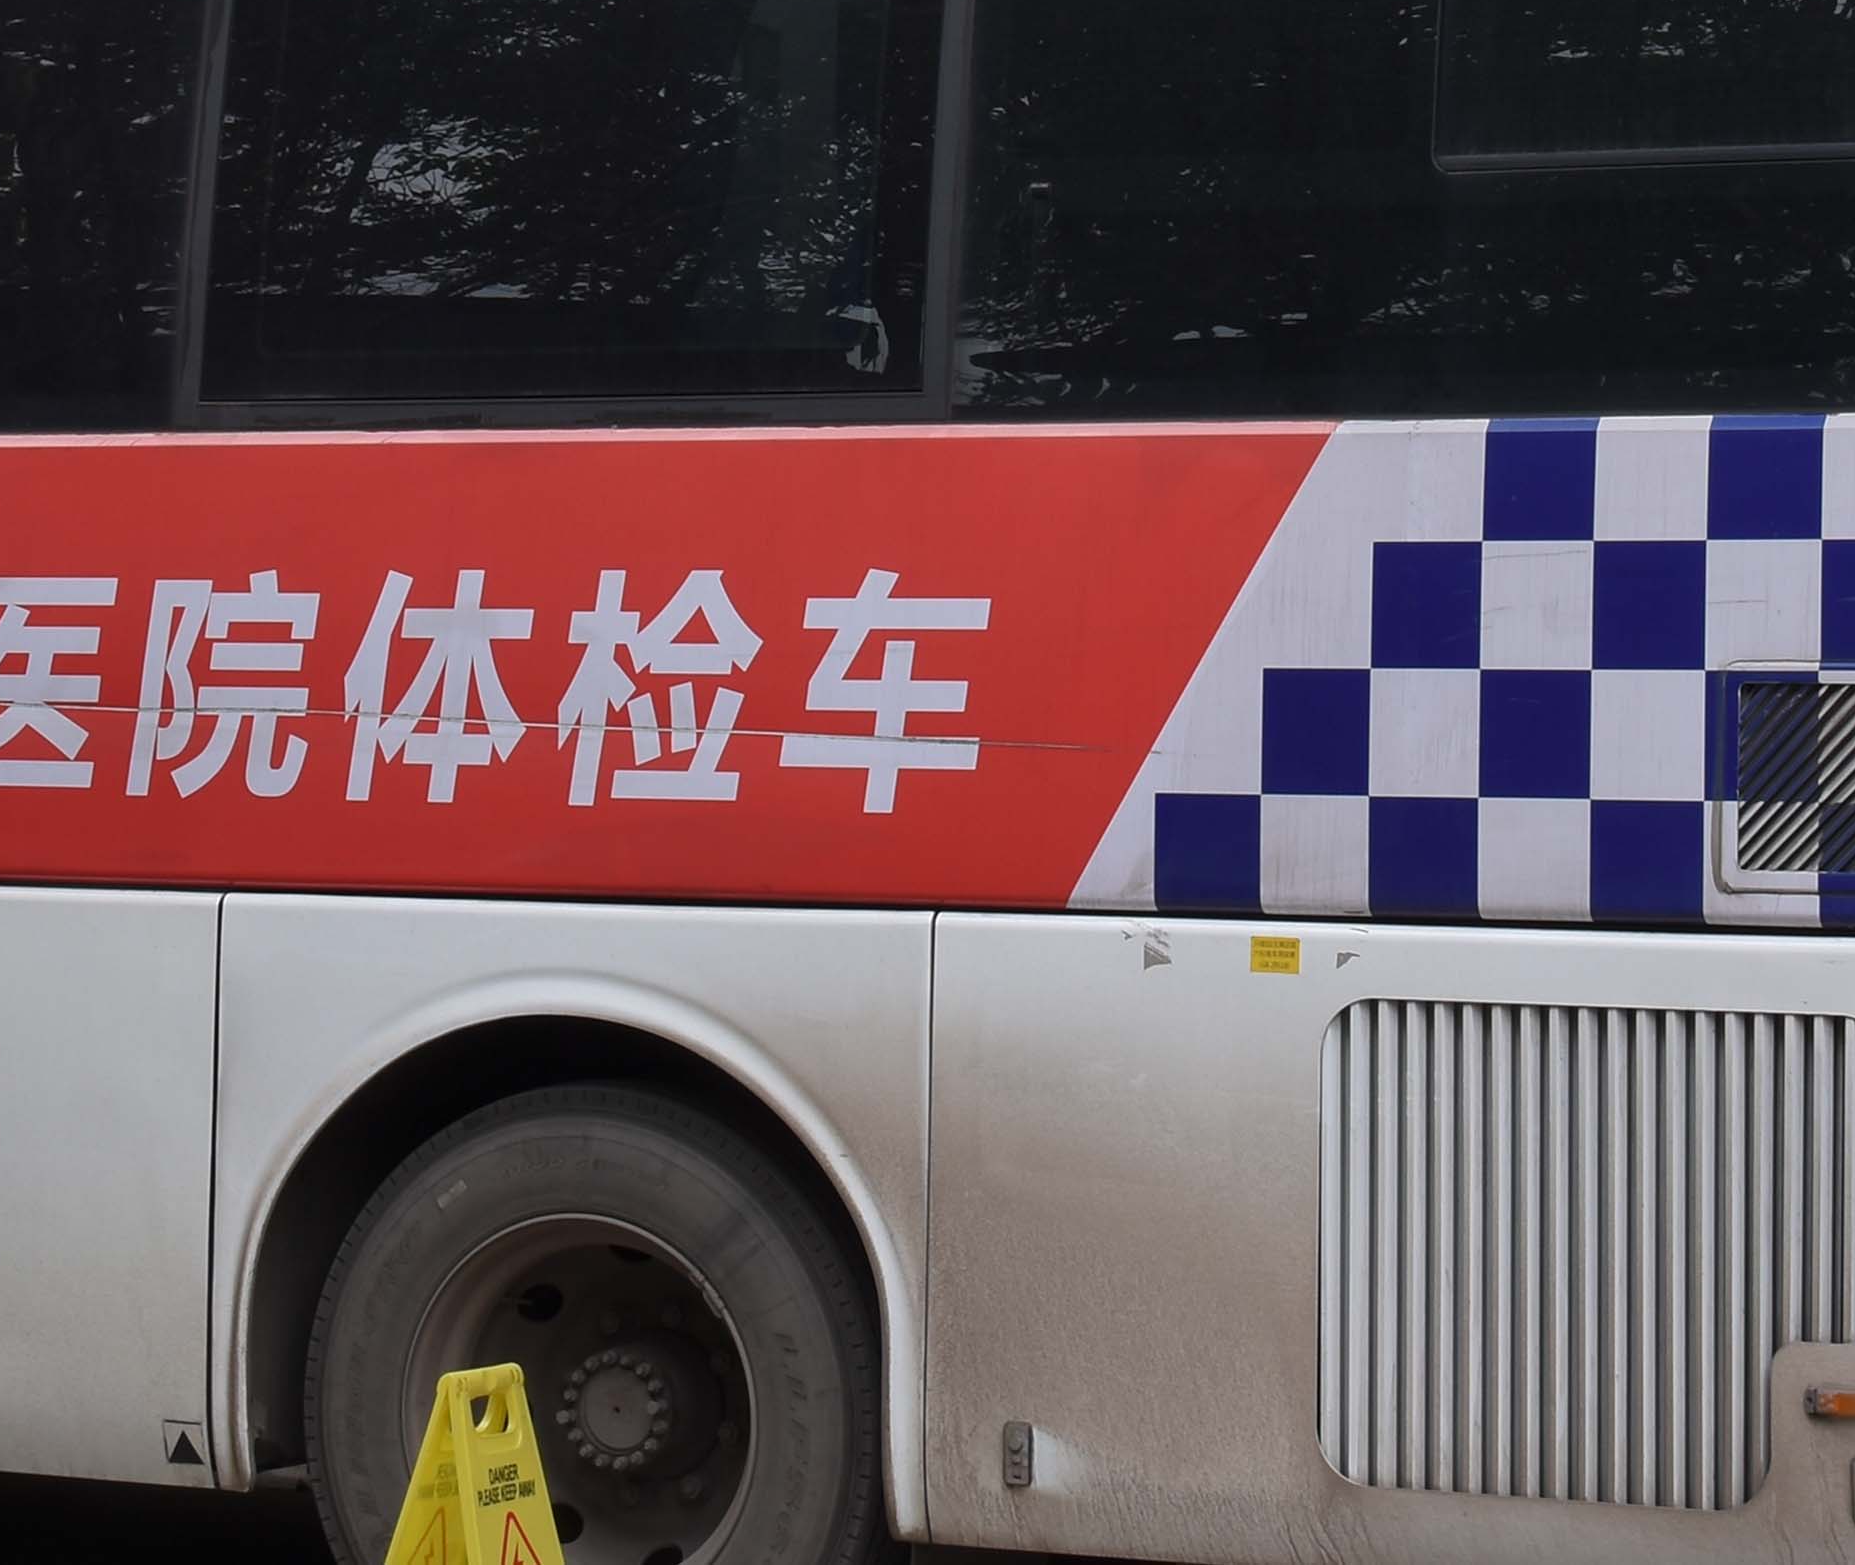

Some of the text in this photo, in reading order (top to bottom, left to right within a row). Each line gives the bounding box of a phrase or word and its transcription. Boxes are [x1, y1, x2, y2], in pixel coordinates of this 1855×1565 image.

[488, 1464, 519, 1485] DANGER
[477, 1486, 501, 1507] PLEASE
[501, 1482, 518, 1501] KEEP
